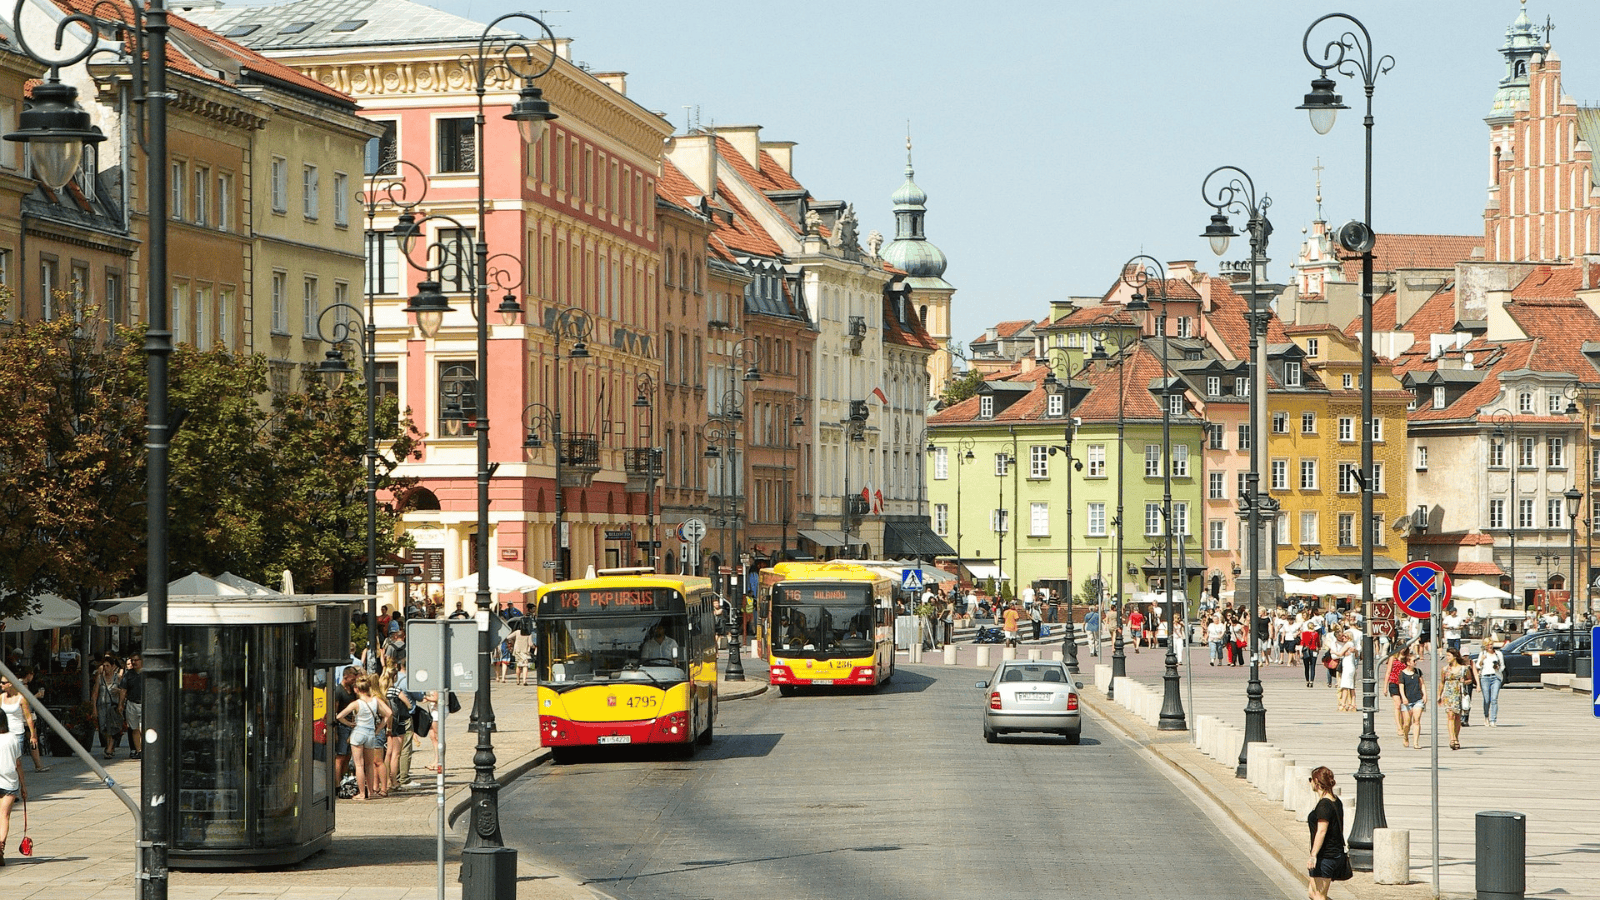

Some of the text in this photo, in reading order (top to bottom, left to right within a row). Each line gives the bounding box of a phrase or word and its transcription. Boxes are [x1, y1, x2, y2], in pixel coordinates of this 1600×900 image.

[560, 591, 653, 608] 178 PKP URSUS
[784, 589, 801, 600] 116
[1372, 623, 1384, 634] WC
[836, 660, 852, 669] 236
[626, 695, 657, 708] 4795
